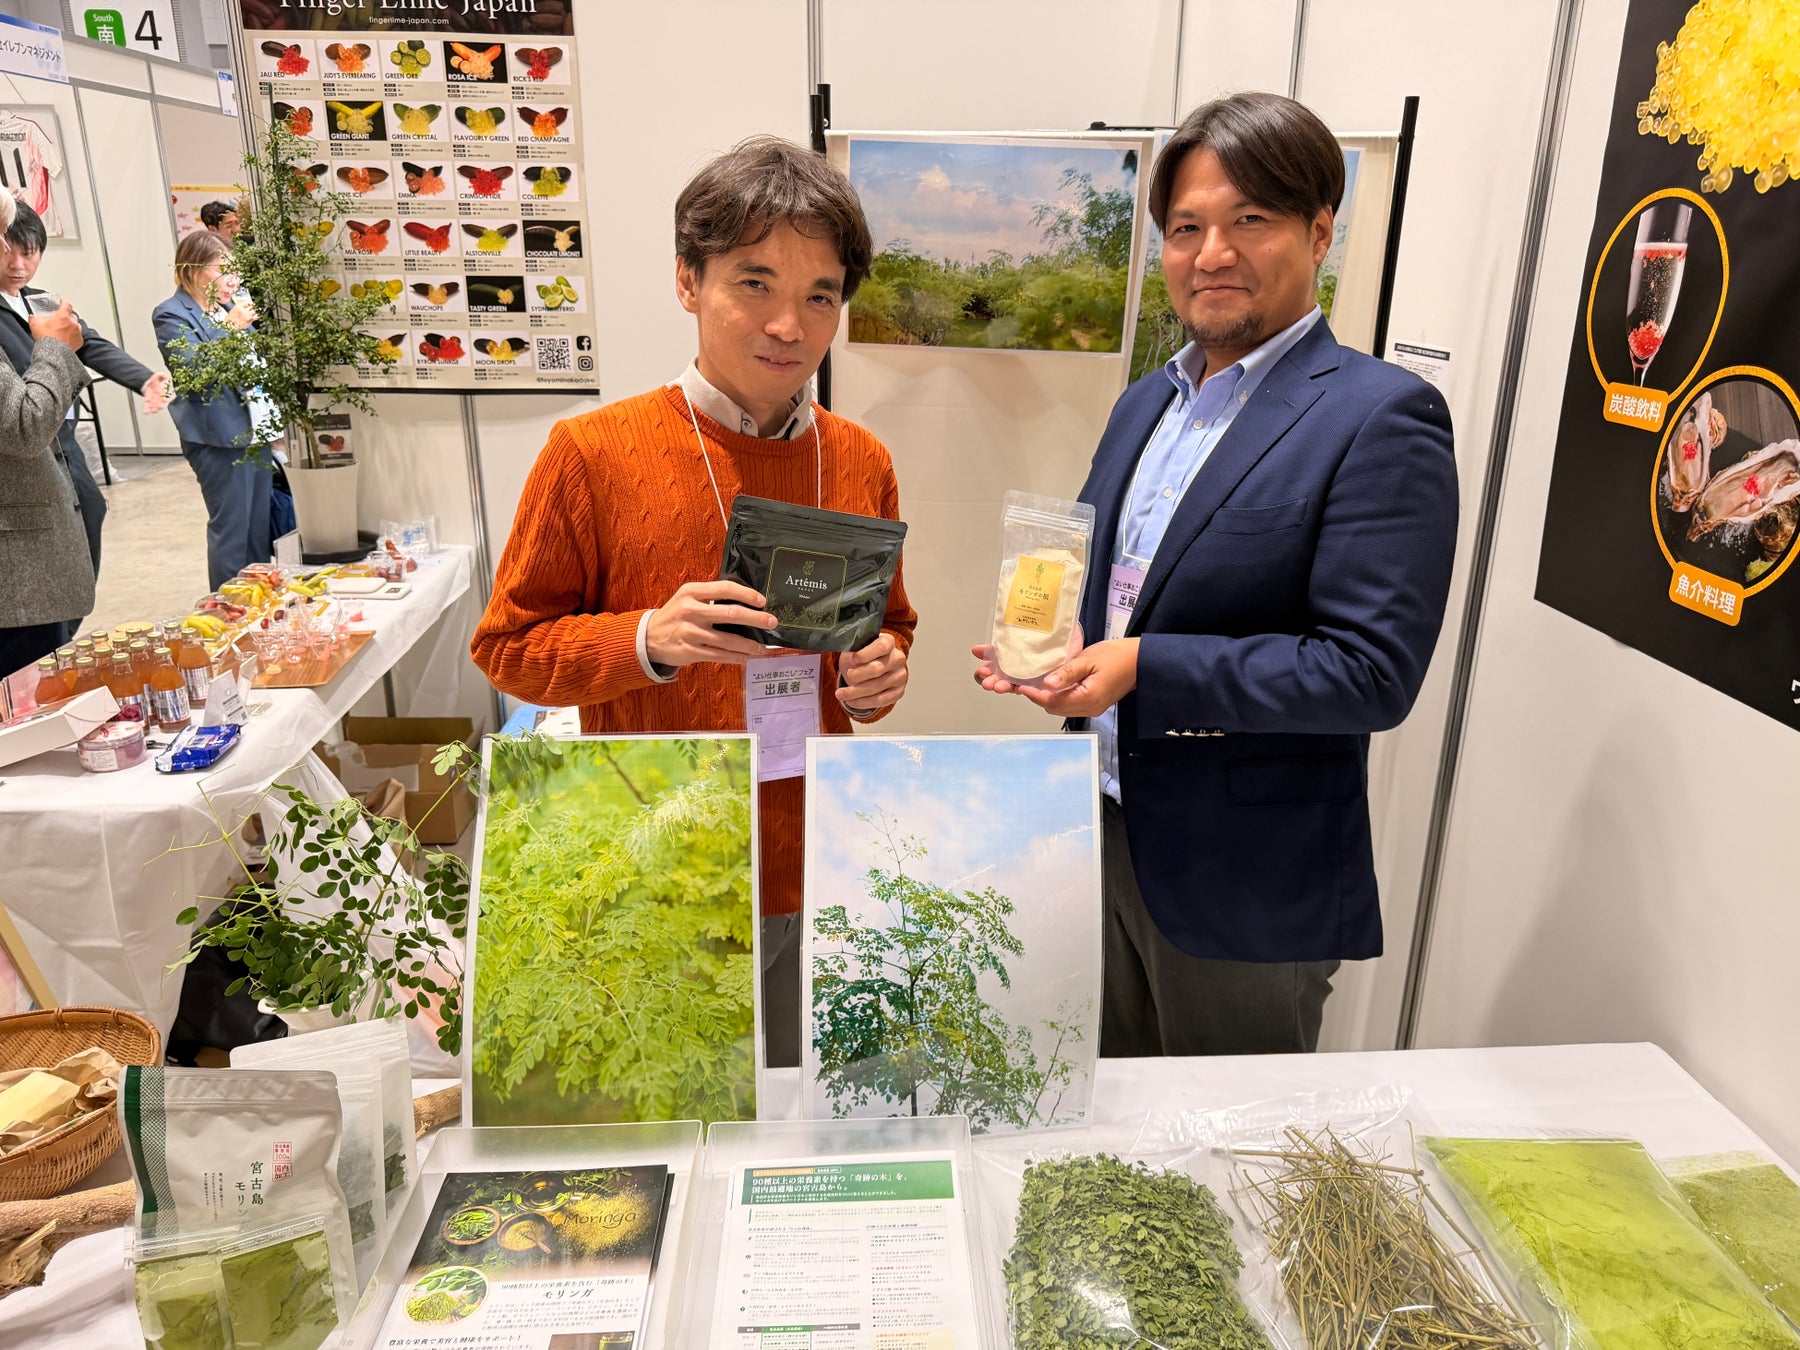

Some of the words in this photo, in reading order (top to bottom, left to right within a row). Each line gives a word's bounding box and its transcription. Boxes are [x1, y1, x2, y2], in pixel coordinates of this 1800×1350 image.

[93, 13, 114, 22] South
[368, 16, 450, 25] fingerlime-japan.com
[97, 24, 116, 45] 南
[134, 10, 163, 51] 4
[448, 73, 465, 81] ROSA
[466, 74, 478, 82] ICE
[487, 305, 507, 313] GREEN
[1608, 393, 1663, 423] 炭酸飲料
[785, 575, 828, 590] Artémis
[1674, 573, 1737, 616] 魚介料理
[765, 681, 802, 696] 出展者
[274, 1164, 289, 1172] 国内
[250, 1161, 264, 1206] 宮古島
[274, 1172, 290, 1180] 加工
[563, 1211, 636, 1229] Moringa
[543, 1288, 594, 1299] モリンガ
